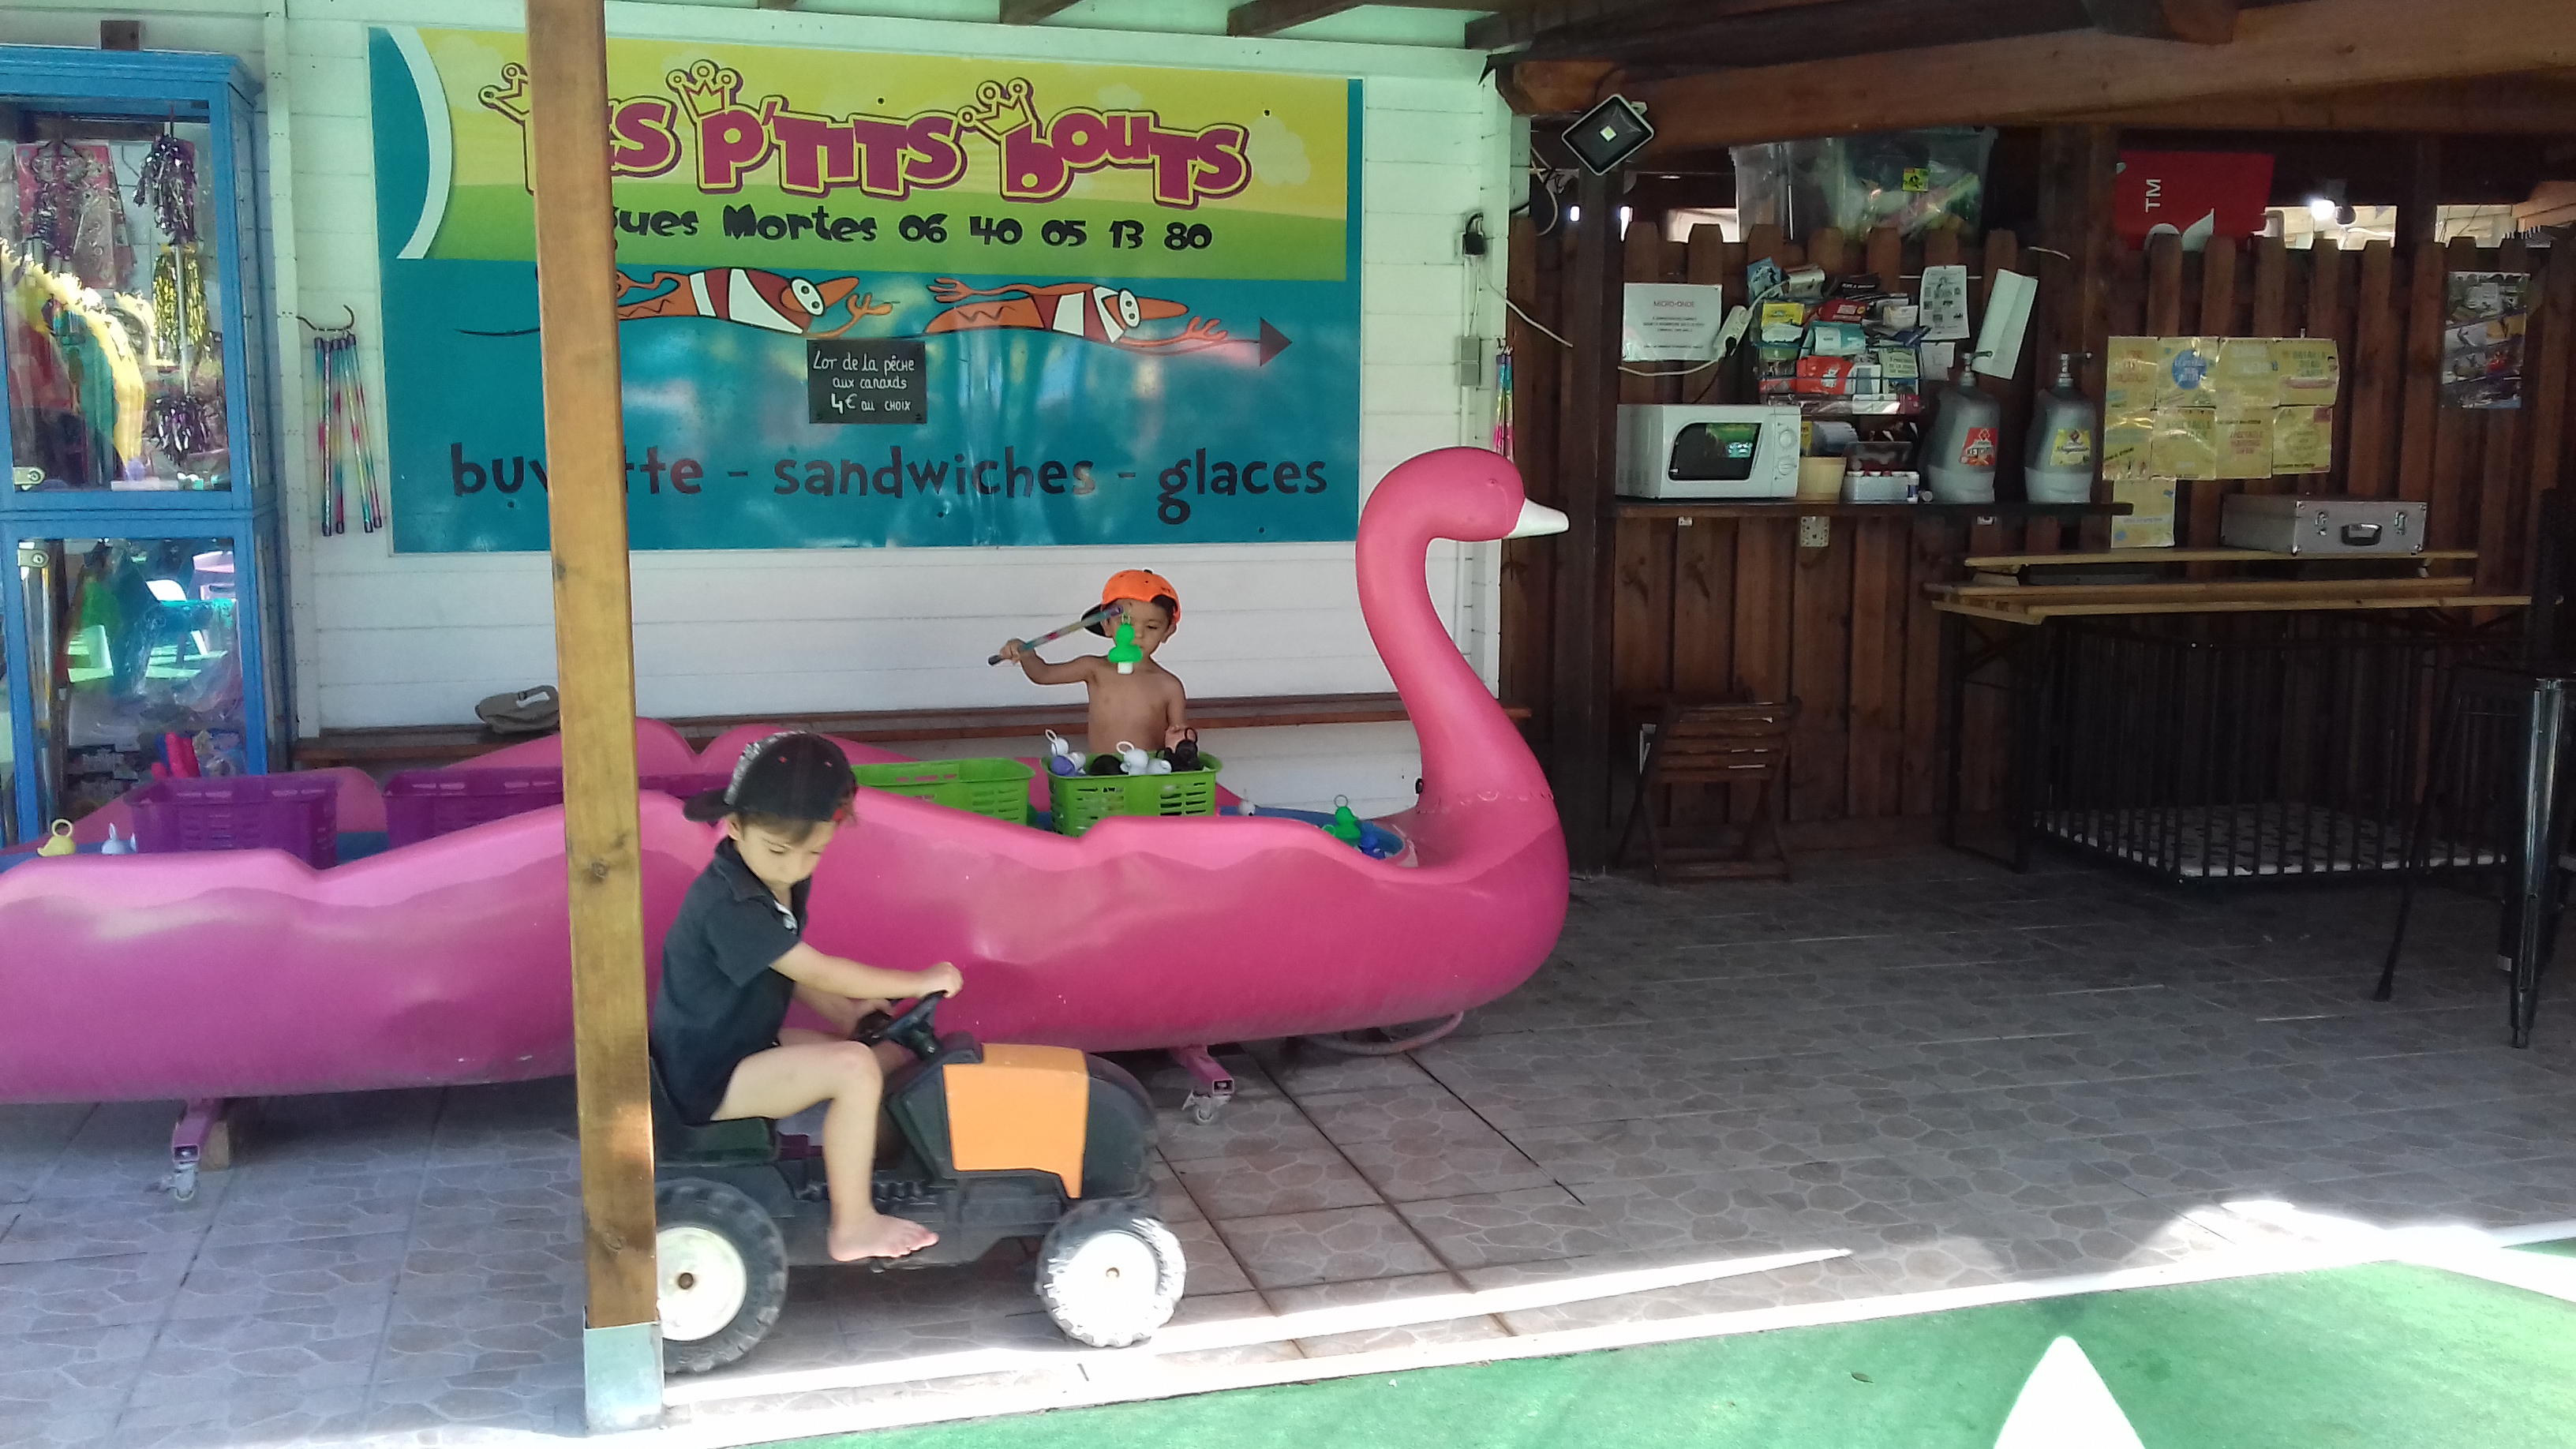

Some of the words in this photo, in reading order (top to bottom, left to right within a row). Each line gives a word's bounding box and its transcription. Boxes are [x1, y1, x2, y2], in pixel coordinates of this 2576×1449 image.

[2145, 178, 2162, 213] TM
[613, 206, 699, 238] ues
[723, 204, 878, 242] Mortes
[898, 213, 949, 243] 06
[969, 215, 1024, 245] 40
[1041, 219, 1088, 248] 05
[1109, 219, 1144, 249] 13
[1163, 222, 1214, 251] 80
[842, 352, 859, 371] de
[861, 353, 878, 372] la
[833, 377, 854, 388] aux
[859, 376, 908, 390] canards
[831, 393, 858, 414] 4€
[861, 400, 875, 411] au
[773, 445, 1095, 498] sandwiches
[1157, 447, 1327, 526] glaces
